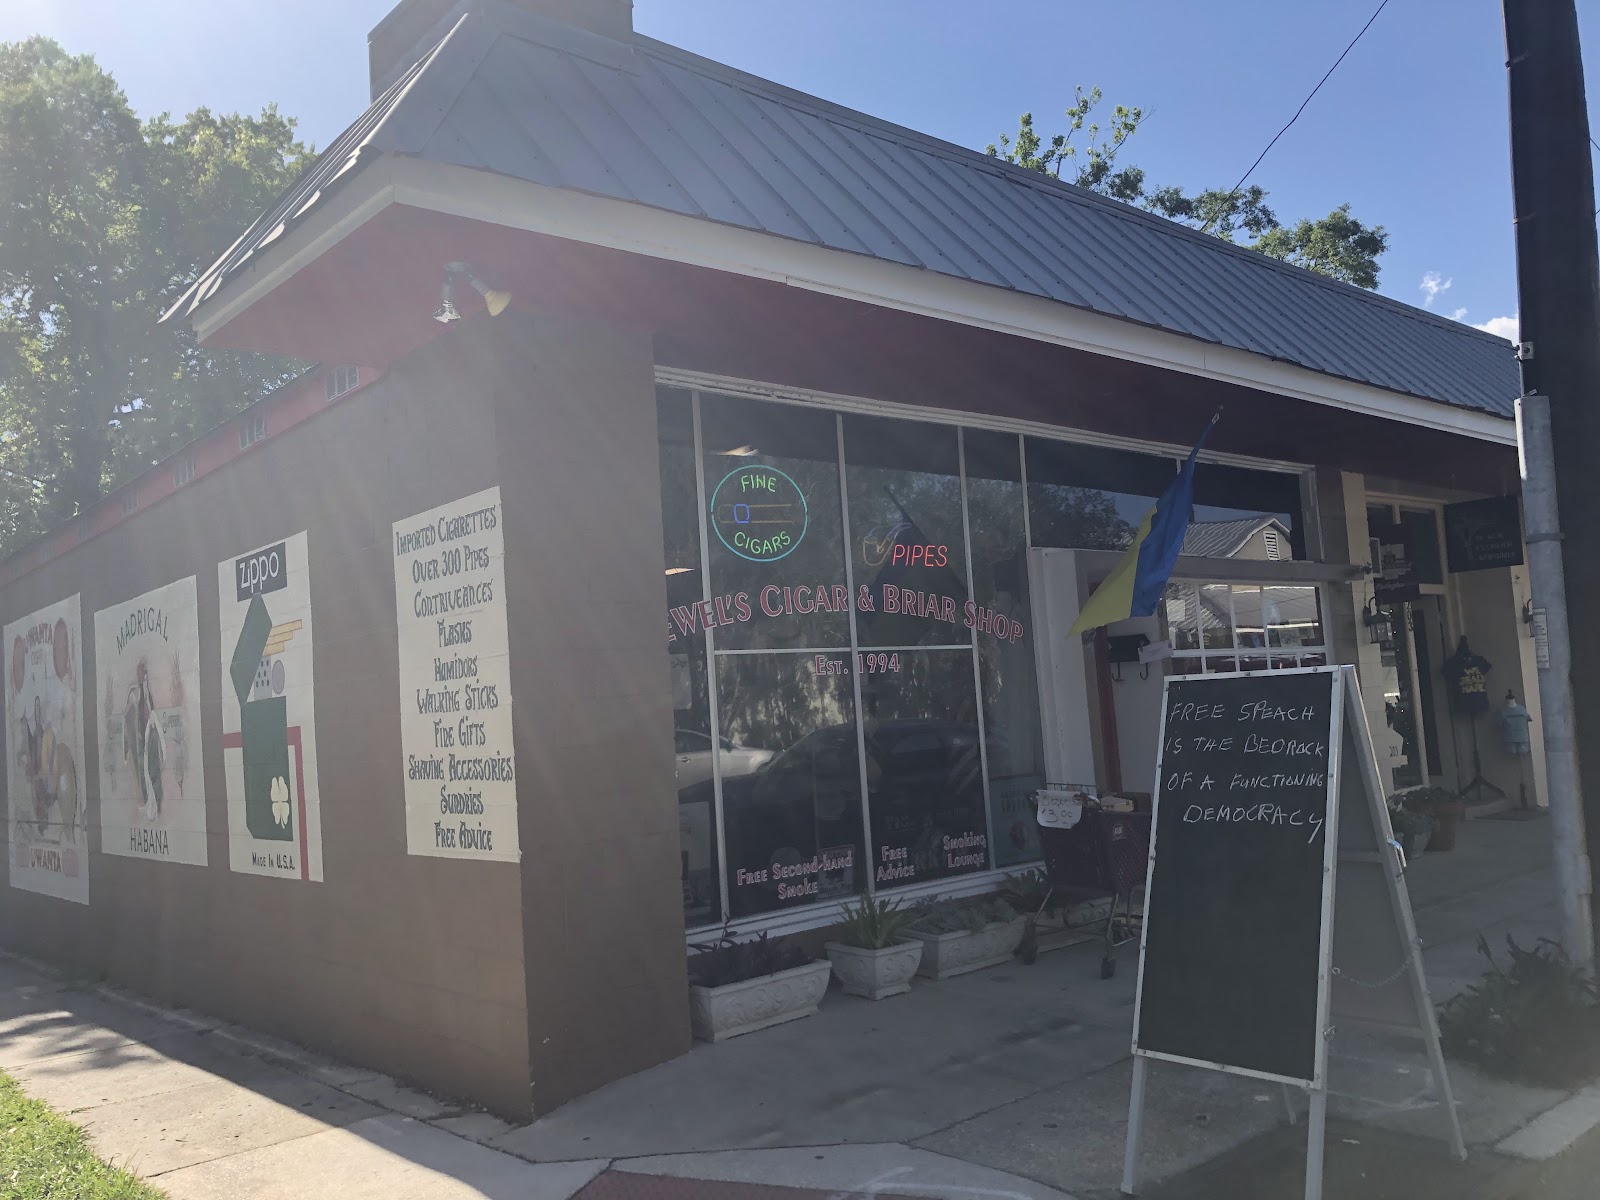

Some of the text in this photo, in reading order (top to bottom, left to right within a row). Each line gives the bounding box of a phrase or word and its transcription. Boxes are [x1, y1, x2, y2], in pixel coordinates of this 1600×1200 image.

[741, 474, 777, 493] FINE
[396, 505, 497, 556] IMPORTED CIGARETTES
[734, 530, 791, 554] CIGARS
[412, 544, 490, 584] OVER 300 PIPES
[892, 544, 948, 567] PIPES
[668, 584, 1024, 644] WEL'S CIGAR & BRIAR SHOP
[116, 607, 168, 656] MADRIGAL
[437, 619, 472, 648] FLASKS
[434, 653, 478, 682] HUMIDORS
[858, 653, 900, 675] 1994
[416, 679, 498, 714] WALKING STICKS
[1169, 700, 1315, 722] FREE SPEACH
[433, 716, 486, 748] FINE GIFTS
[1166, 733, 1325, 756] IS THE BEDROCK
[408, 750, 513, 783] SHAVING ACCESSORIES
[1167, 771, 1323, 791] OF A FUNCTIONING
[440, 785, 484, 815] SUNDRIES
[434, 820, 492, 851] FREE ADVICE
[1183, 803, 1323, 844] DEMOCRACY
[130, 828, 169, 855] HABANA
